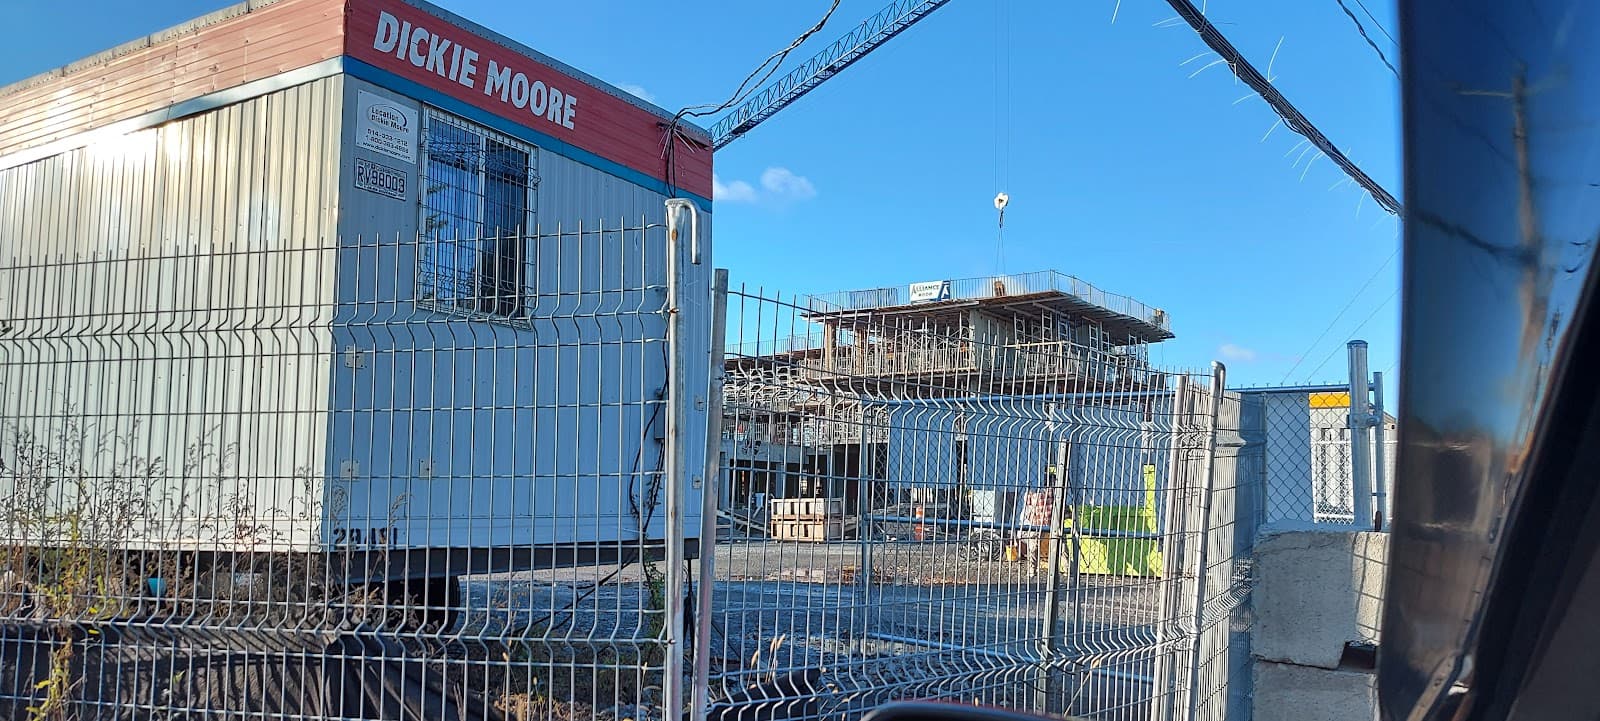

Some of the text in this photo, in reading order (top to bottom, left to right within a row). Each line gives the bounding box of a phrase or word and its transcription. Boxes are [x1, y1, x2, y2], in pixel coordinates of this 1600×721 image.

[373, 10, 577, 130] DICKIE MOORE
[371, 106, 399, 121] Location
[357, 165, 405, 193] RV98003
[911, 284, 940, 297] ALLIANCE
